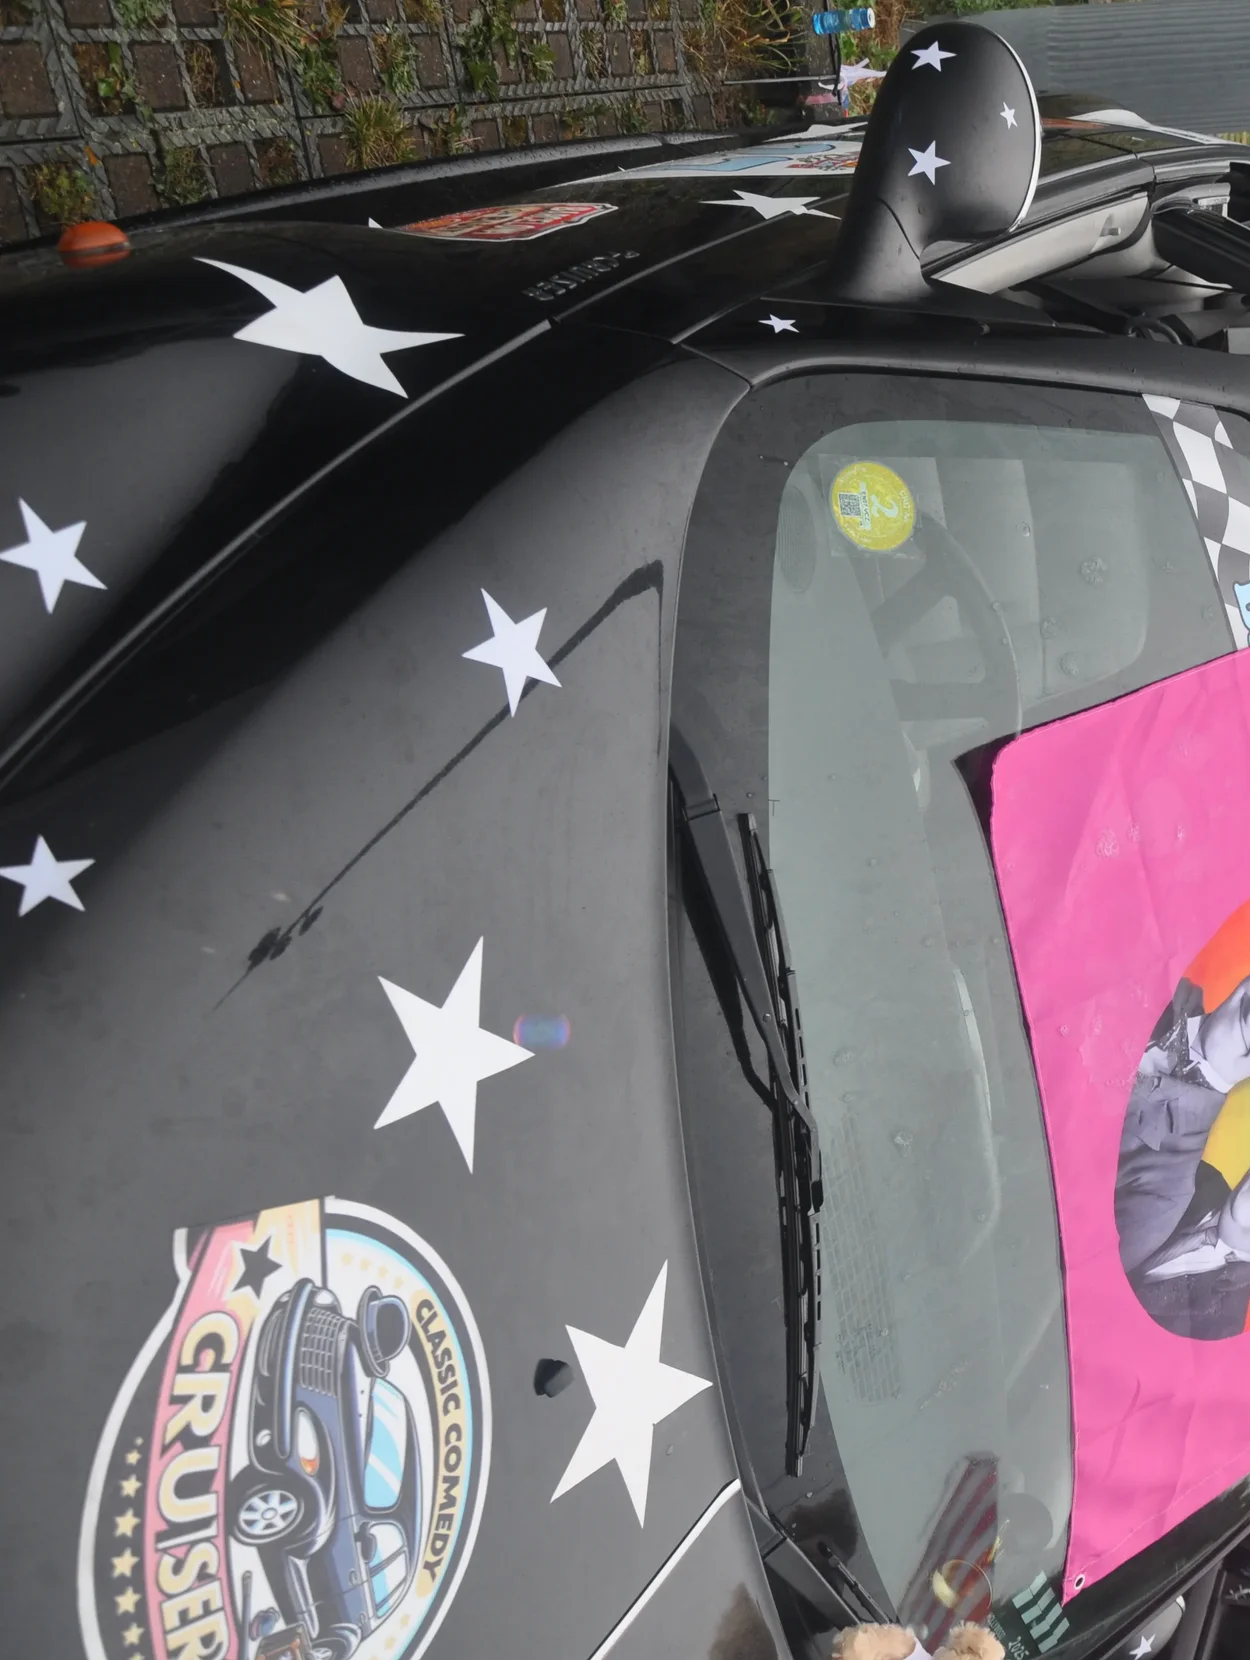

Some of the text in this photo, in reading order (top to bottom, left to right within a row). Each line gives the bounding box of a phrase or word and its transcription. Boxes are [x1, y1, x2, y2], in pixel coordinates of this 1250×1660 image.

[521, 256, 619, 302] CRUISER
[871, 494, 899, 518] 2
[413, 1299, 463, 1583] CLASSIC COMEDY
[1008, 1636, 1030, 1660] 2025
